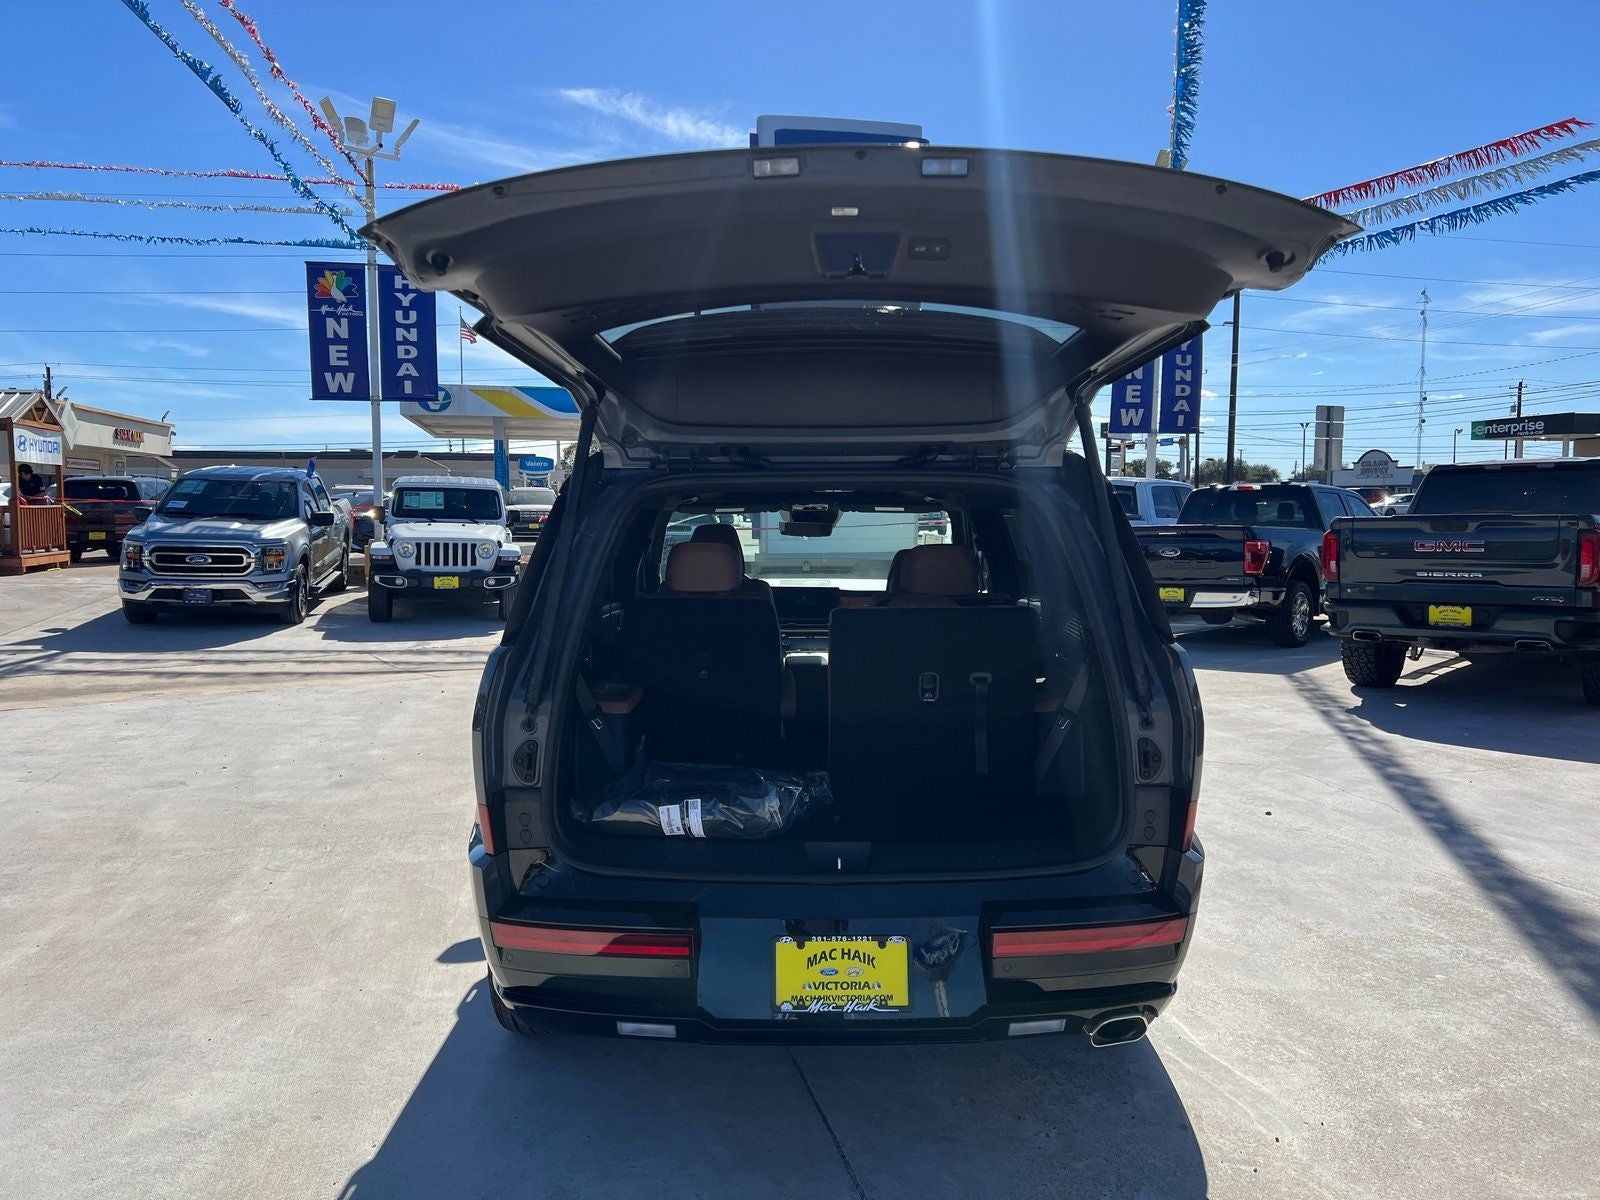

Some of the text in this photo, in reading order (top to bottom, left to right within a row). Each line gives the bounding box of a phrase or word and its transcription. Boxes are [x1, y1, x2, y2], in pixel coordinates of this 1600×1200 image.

[394, 275, 419, 394] HYUNDAI
[323, 317, 355, 393] NEW
[1475, 420, 1545, 435] enterprise
[29, 438, 60, 454] HYUNDAI
[1414, 540, 1485, 552] GMC
[806, 948, 876, 969] MAC HAIK
[812, 981, 872, 991] VICTORIA
[807, 998, 880, 1013] Mac Haik
